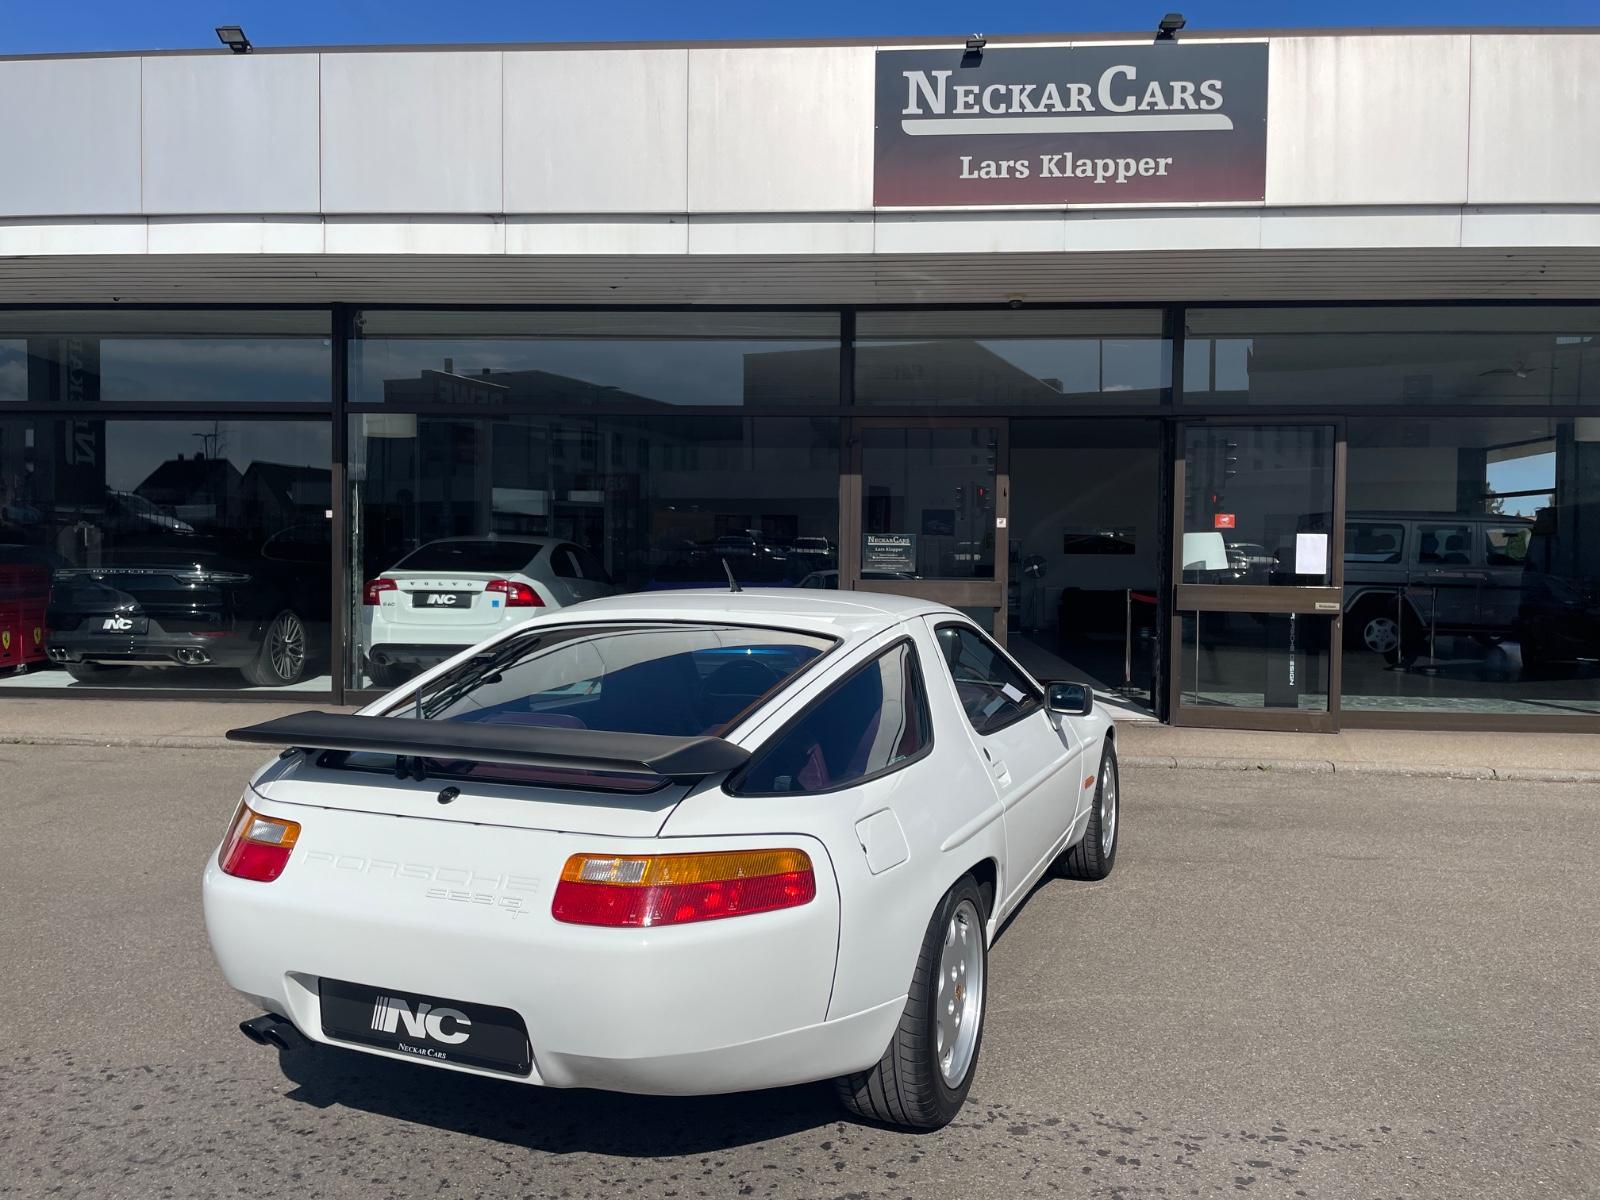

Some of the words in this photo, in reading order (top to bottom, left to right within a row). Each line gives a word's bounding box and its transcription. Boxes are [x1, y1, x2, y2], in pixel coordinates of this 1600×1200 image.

[902, 64, 1224, 115] NECKARCARS
[959, 156, 1030, 180] Lars
[1039, 152, 1172, 183] Klapper
[301, 849, 541, 894] PORSCHE
[398, 1042, 427, 1056] NECKAR
[427, 1047, 447, 1060] CARS
